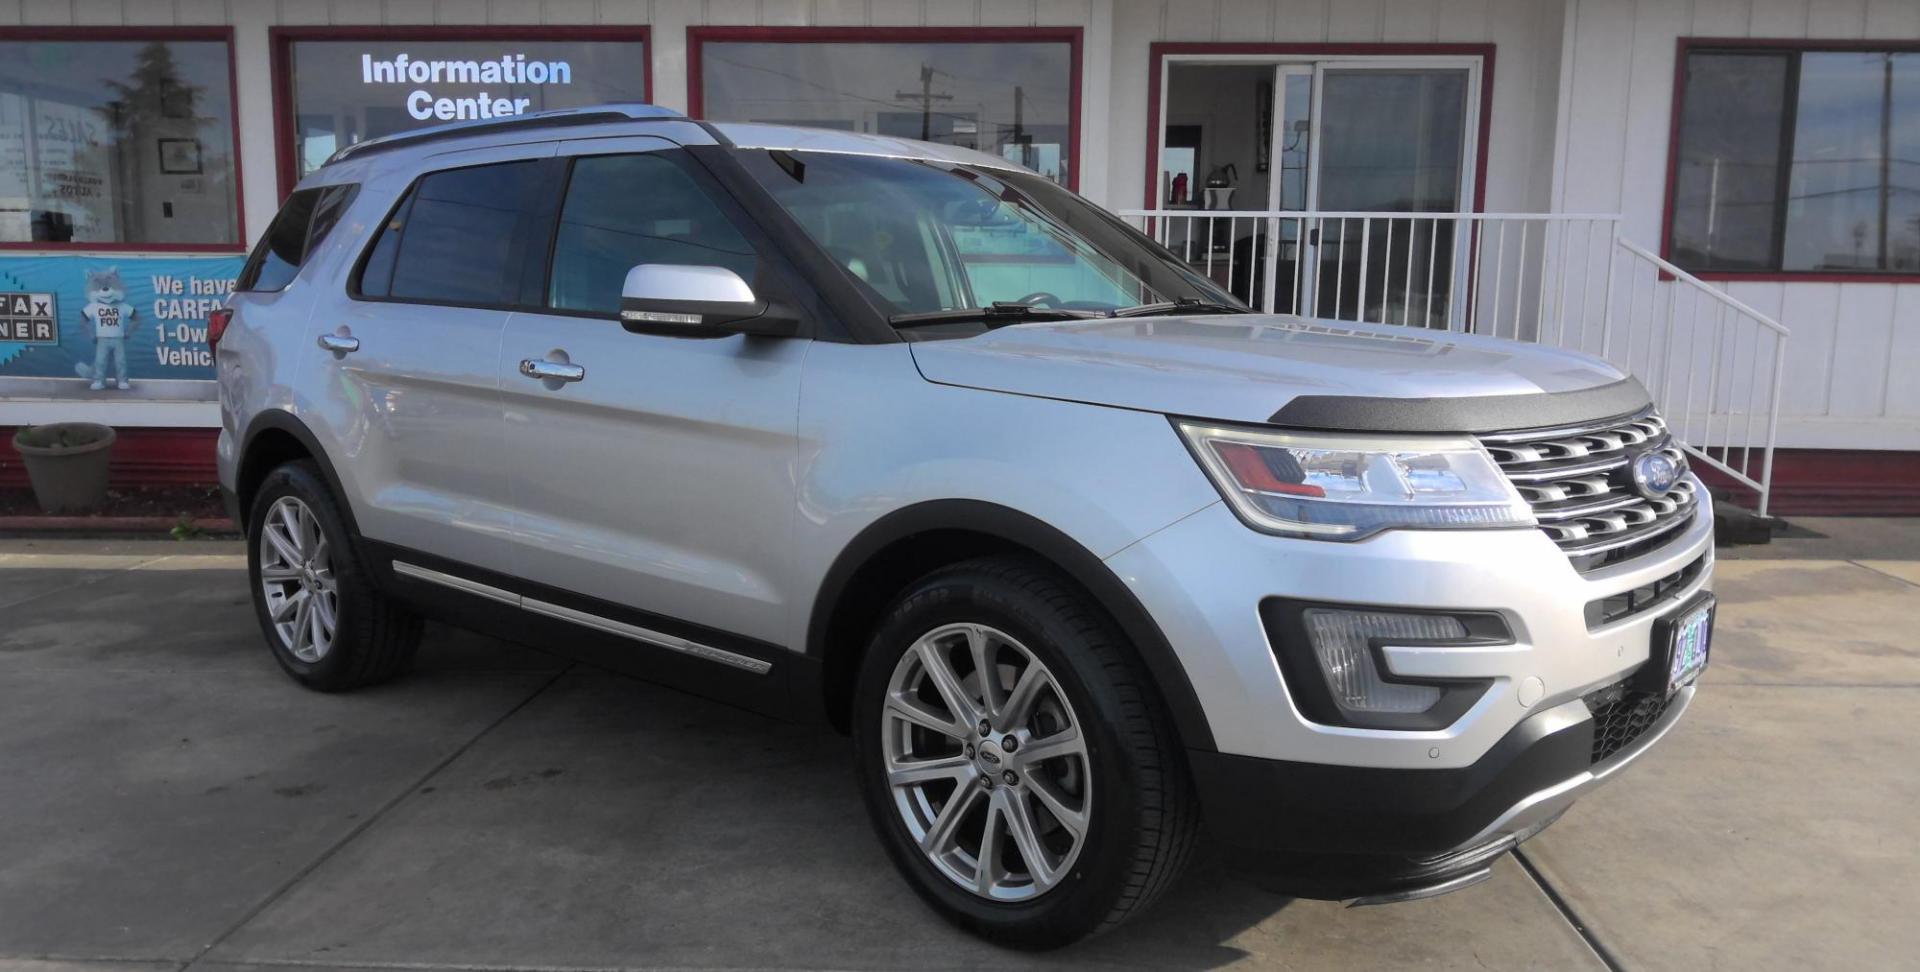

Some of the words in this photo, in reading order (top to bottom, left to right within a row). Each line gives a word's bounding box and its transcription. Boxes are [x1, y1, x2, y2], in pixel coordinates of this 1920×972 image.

[362, 54, 571, 84] Information
[407, 90, 530, 120] Center
[153, 275, 183, 295] We
[190, 275, 237, 295] have
[98, 307, 119, 317] CAR
[100, 317, 120, 327] FOX
